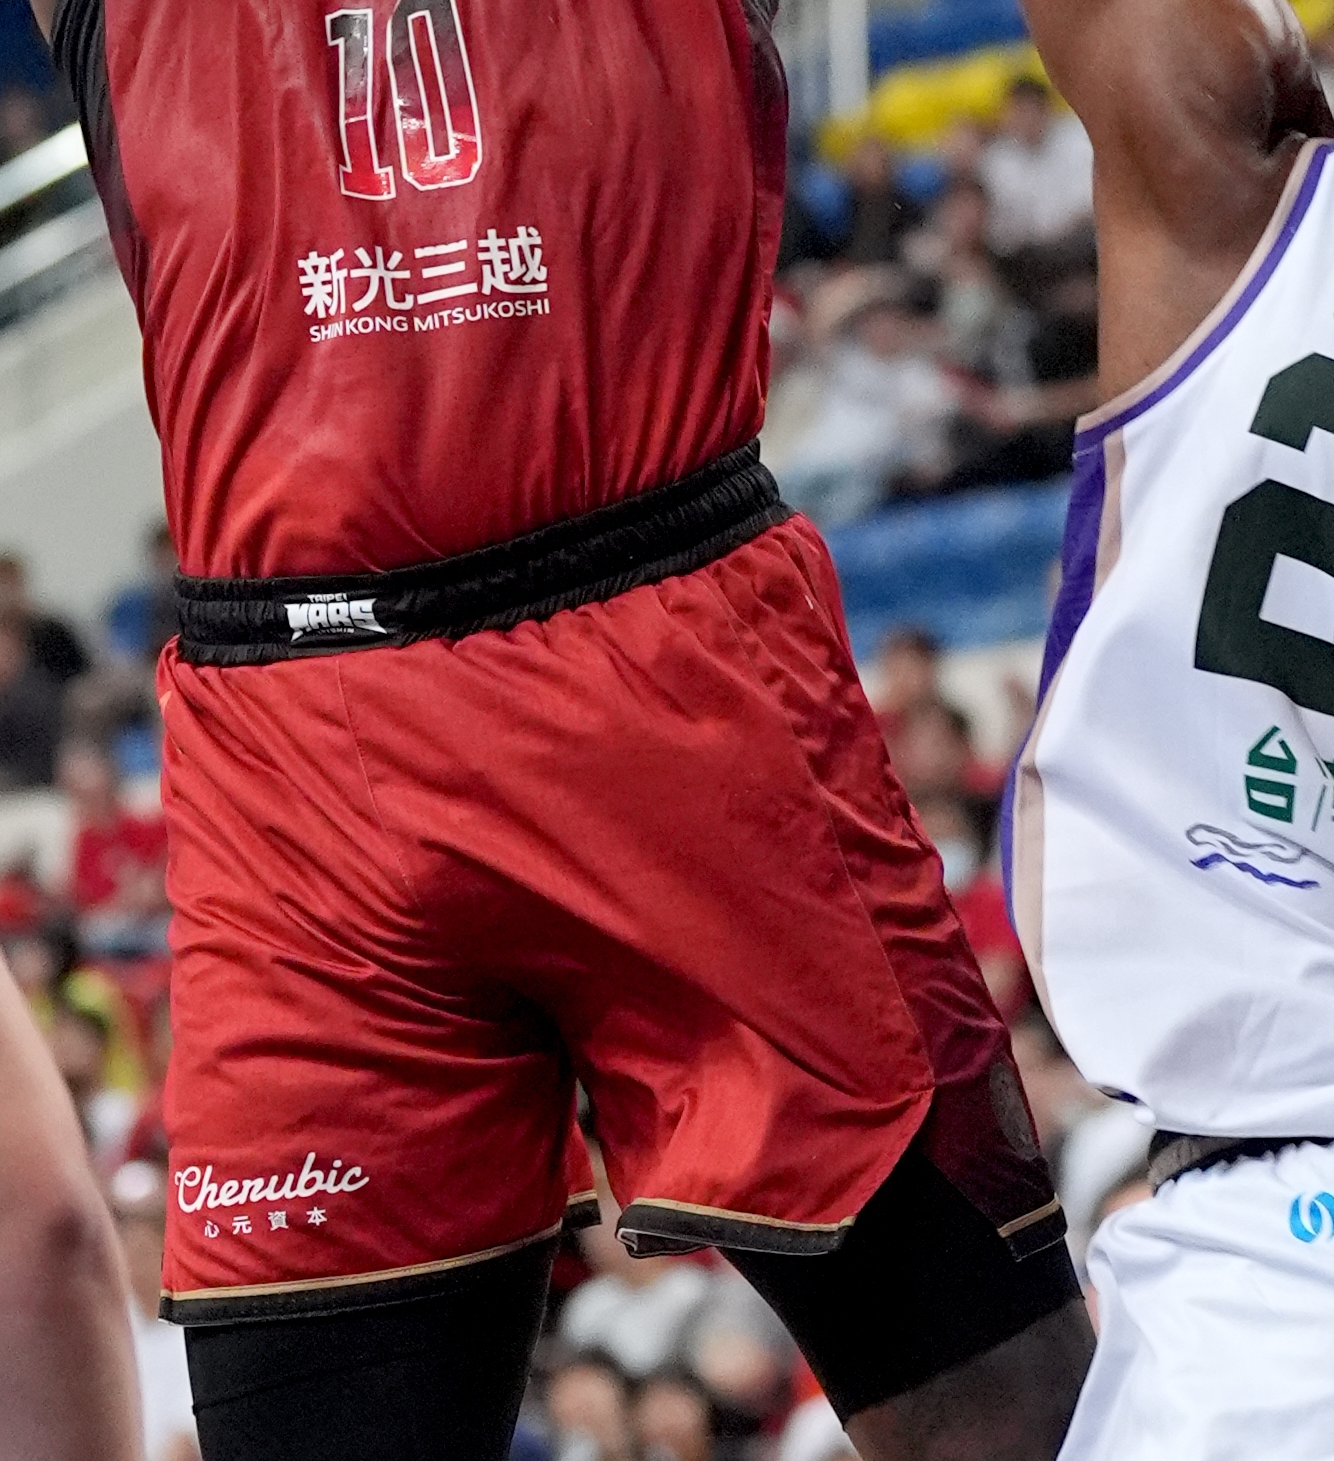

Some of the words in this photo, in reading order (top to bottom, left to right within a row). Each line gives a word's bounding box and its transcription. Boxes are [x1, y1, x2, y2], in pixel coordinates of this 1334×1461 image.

[297, 225, 549, 320] 新光三越
[345, 315, 409, 336] KONG
[413, 297, 551, 333] MITSUKOSHI
[173, 1151, 370, 1213] Cherubic
[203, 1206, 328, 1239] 心元資本
